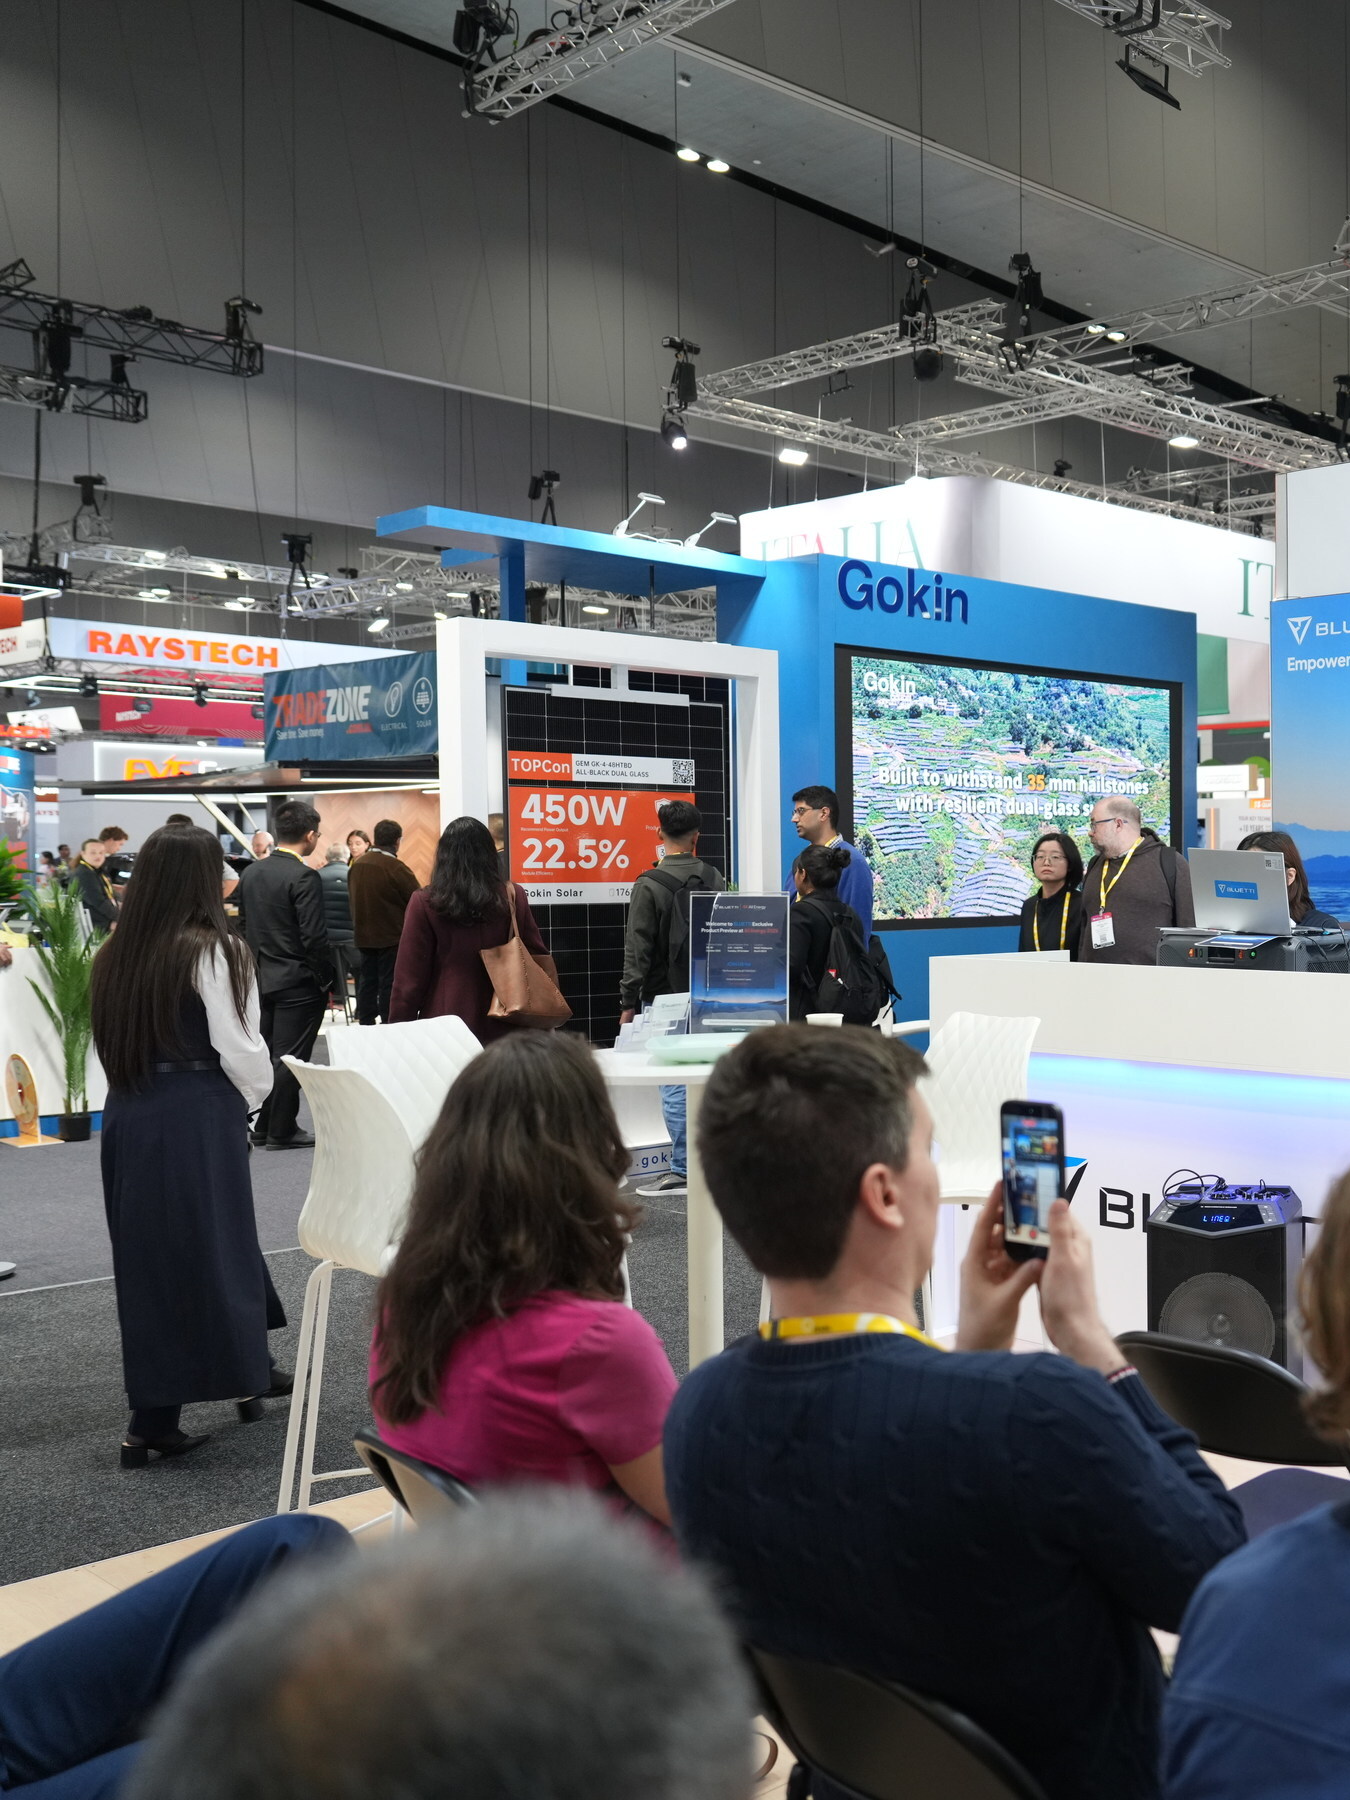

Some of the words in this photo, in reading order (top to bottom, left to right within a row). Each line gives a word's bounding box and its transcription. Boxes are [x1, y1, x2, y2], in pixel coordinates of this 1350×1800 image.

[837, 559, 969, 625] Gokin
[87, 630, 279, 668] RAYSTECH
[863, 671, 916, 696] Gokin
[511, 758, 571, 774] TOPCon
[575, 769, 610, 777] ALL-BLACK
[629, 770, 649, 778] GLASS
[879, 766, 921, 785] Built
[923, 768, 938, 787] to
[943, 770, 1023, 790] withstand
[1027, 774, 1046, 791] 35
[1049, 778, 1076, 793] mm
[1079, 777, 1149, 795] hailstones
[520, 793, 627, 826] 450W
[896, 795, 935, 812] with
[937, 796, 1004, 815] resilient
[1005, 799, 1080, 820] dual-glass
[521, 837, 630, 870] 22.5%
[556, 888, 584, 897] Solar
[1226, 886, 1255, 894] BLUETTI
